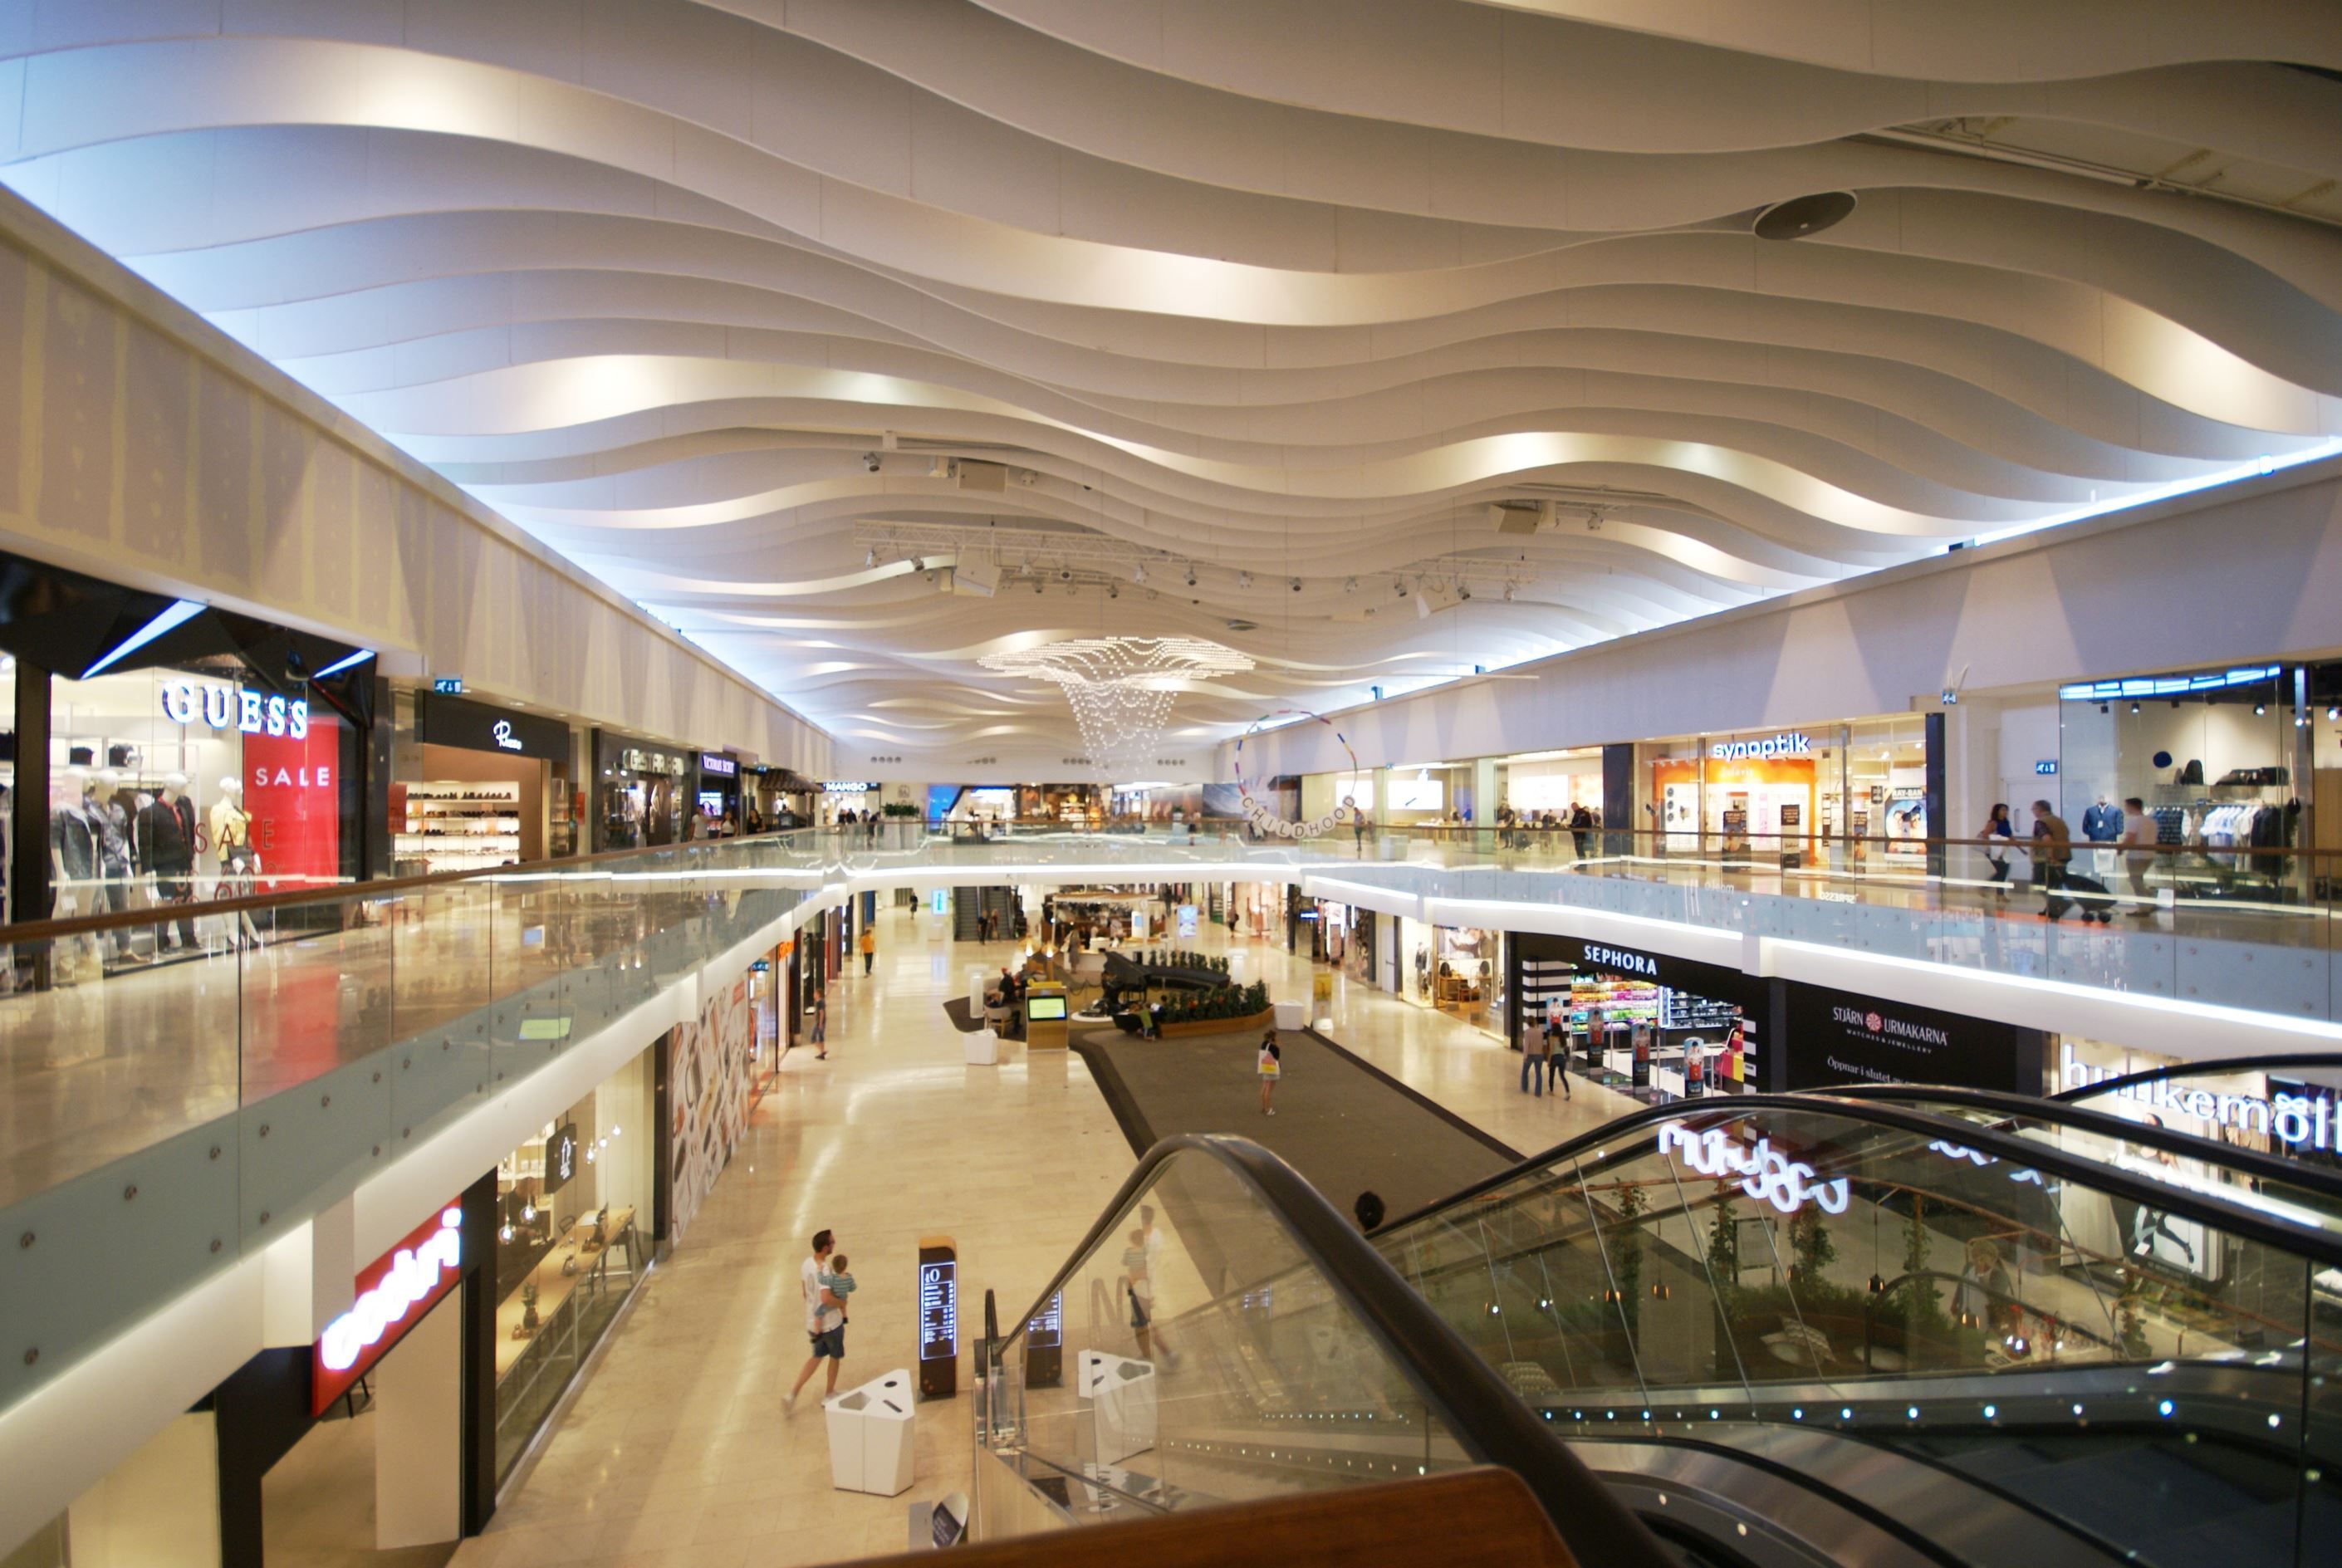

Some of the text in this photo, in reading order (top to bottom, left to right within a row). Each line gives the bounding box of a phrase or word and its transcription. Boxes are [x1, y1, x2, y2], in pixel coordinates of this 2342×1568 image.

[162, 679, 308, 739] GUESS
[1712, 733, 1810, 762] synoptik
[256, 767, 331, 787] SALE
[826, 782, 868, 791] MANGO
[1242, 796, 1355, 837] CHILDHOOD
[194, 821, 275, 854] SALE
[1584, 945, 1657, 976] SEPHORA
[1833, 1006, 1948, 1046] STJÄRN URMAKARNA
[1846, 1028, 1880, 1043] WATCHES
[1888, 1040, 1933, 1055] JEWELLERY
[1827, 1056, 1859, 1075] Öppnar
[1865, 1067, 1891, 1084] slutet
